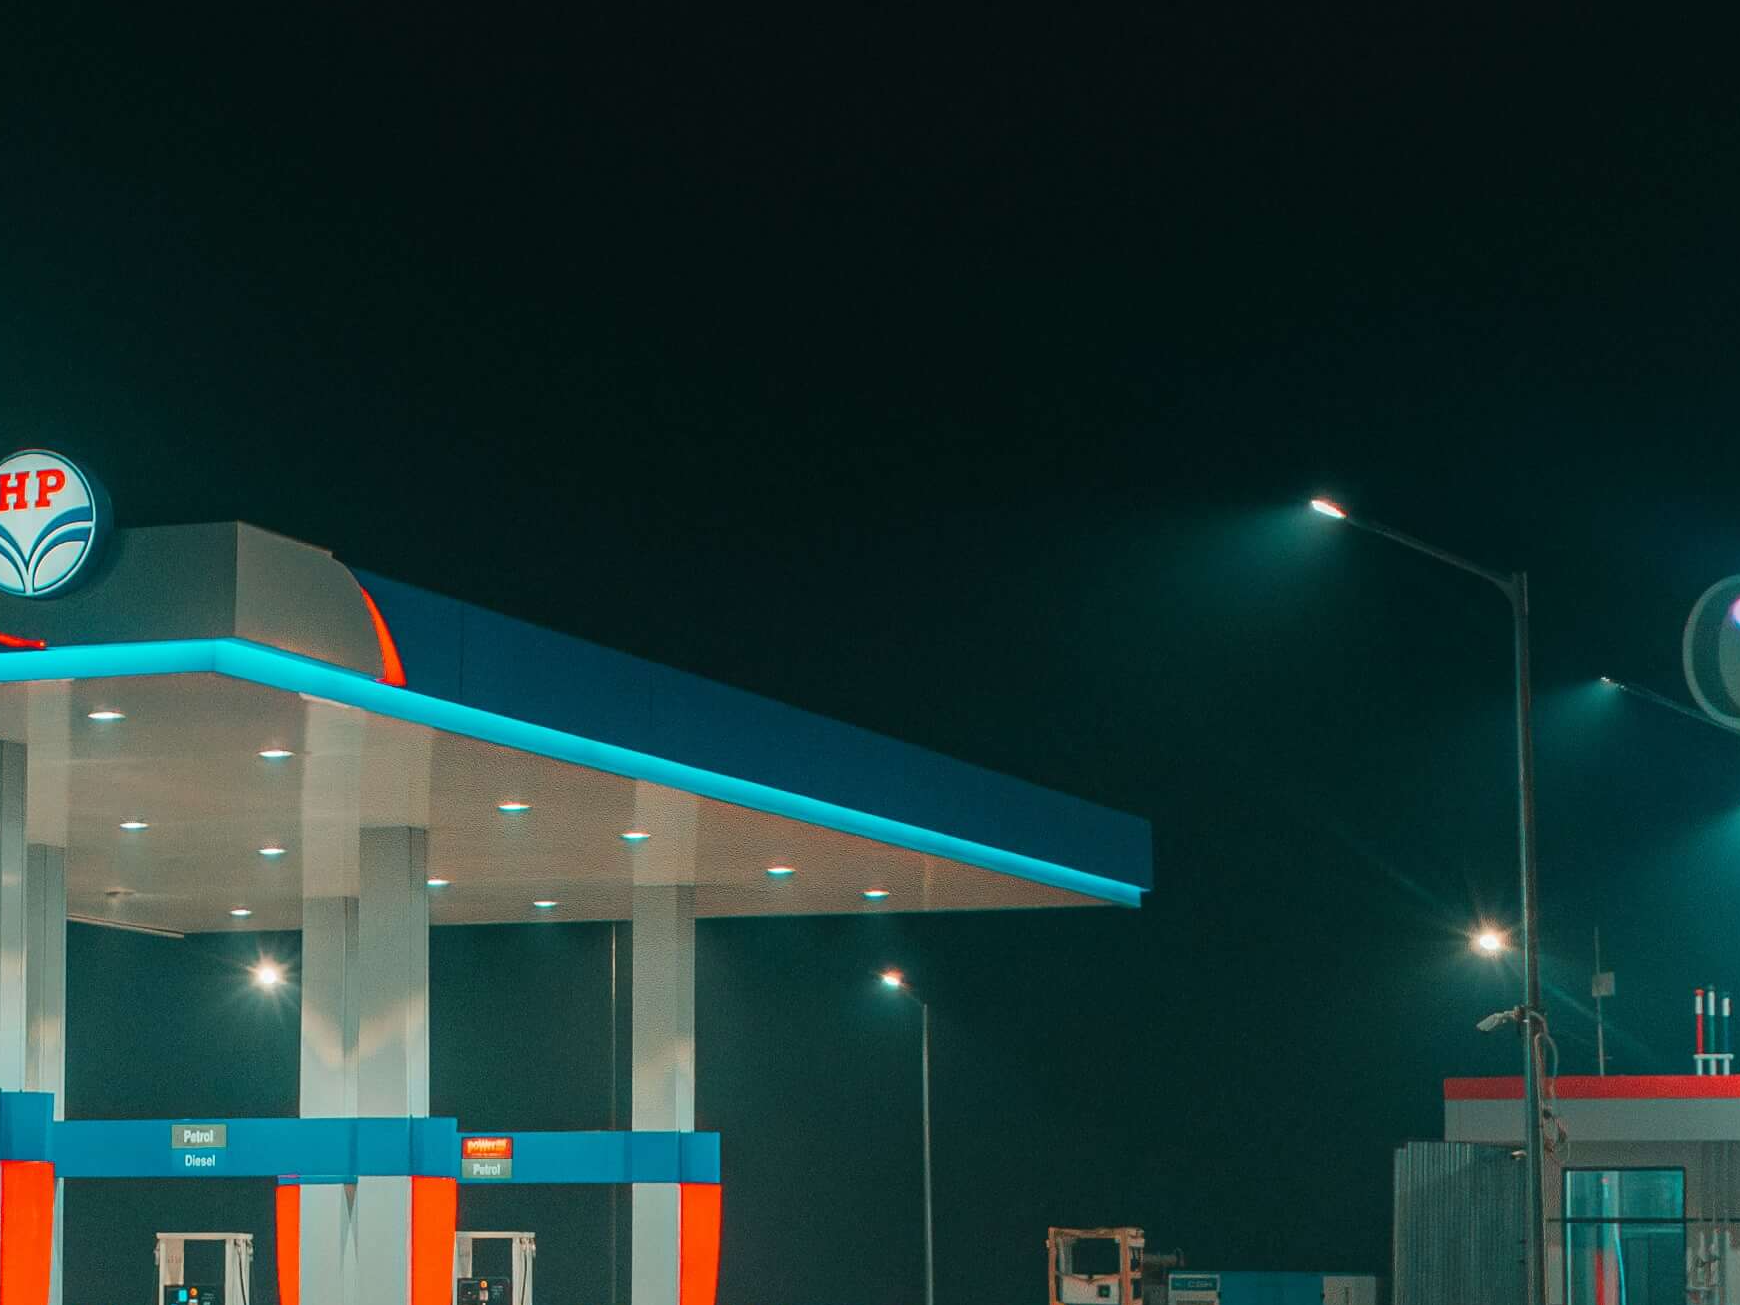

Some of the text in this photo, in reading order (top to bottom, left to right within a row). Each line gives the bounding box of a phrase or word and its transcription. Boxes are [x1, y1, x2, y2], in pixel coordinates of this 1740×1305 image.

[184, 1129, 213, 1143] Petrol
[185, 1154, 216, 1167] Diesel
[473, 1164, 500, 1175] Petrol
